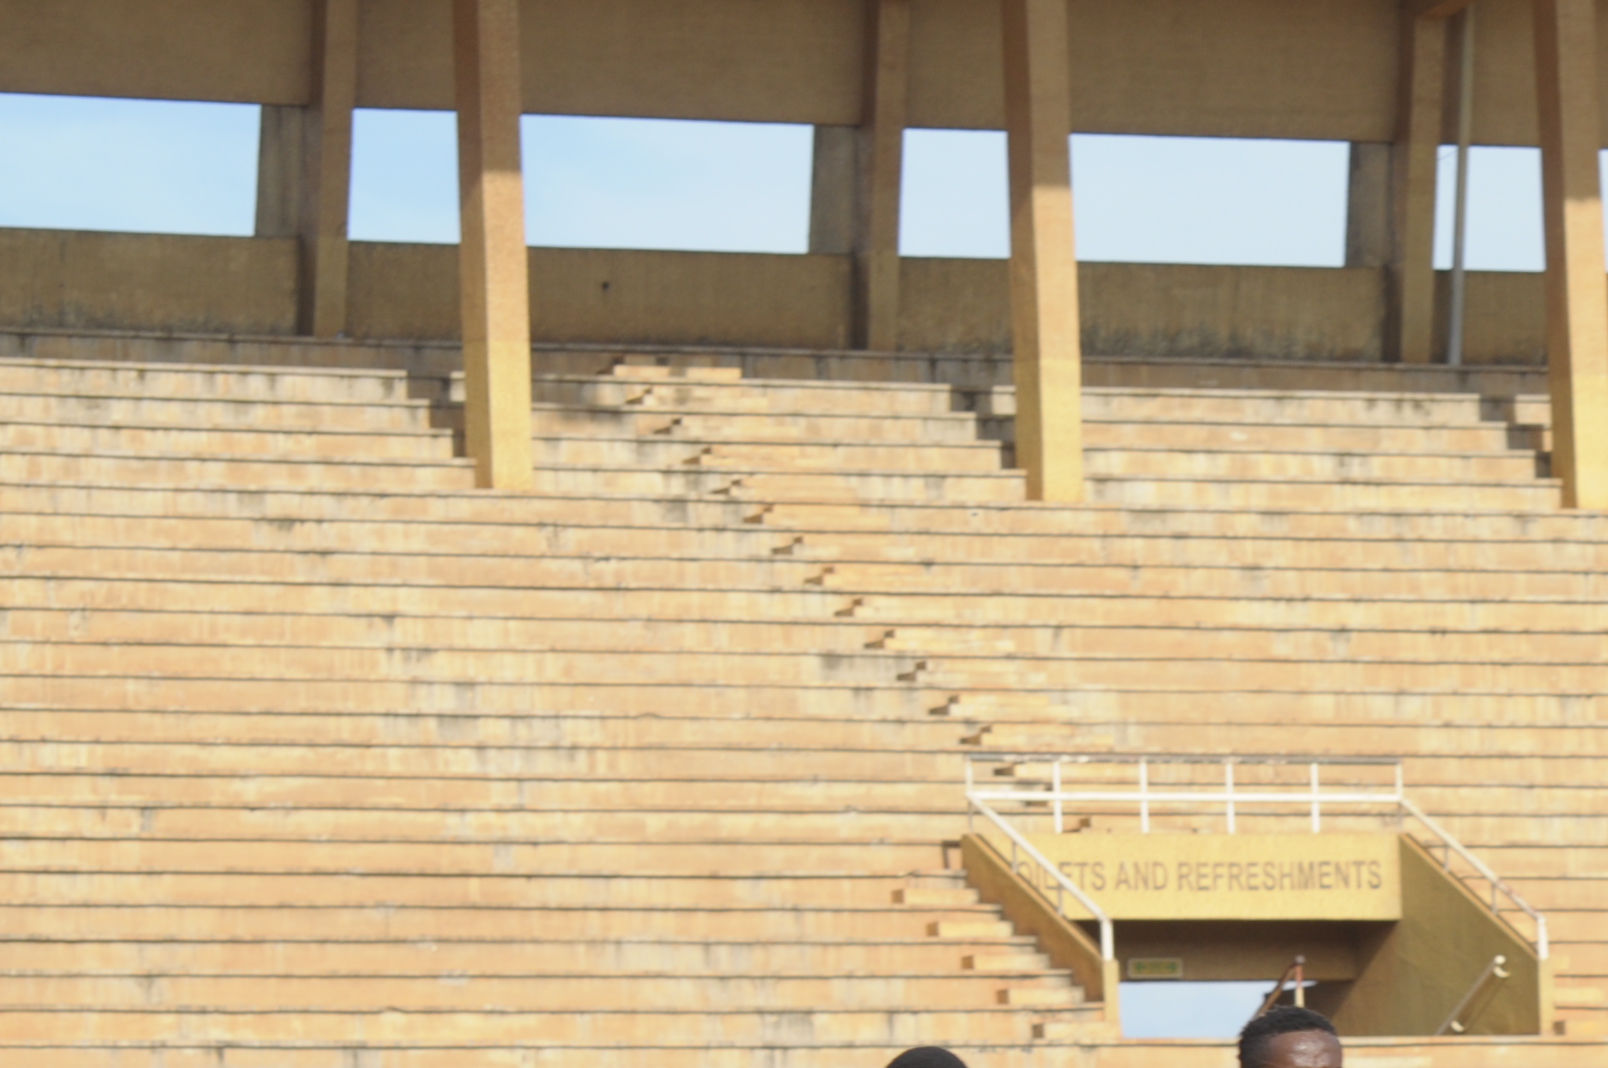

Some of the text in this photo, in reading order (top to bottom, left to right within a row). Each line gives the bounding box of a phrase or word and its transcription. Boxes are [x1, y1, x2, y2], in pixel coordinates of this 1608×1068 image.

[1017, 860, 1383, 891] OILETS AND REFRESHMENTS
